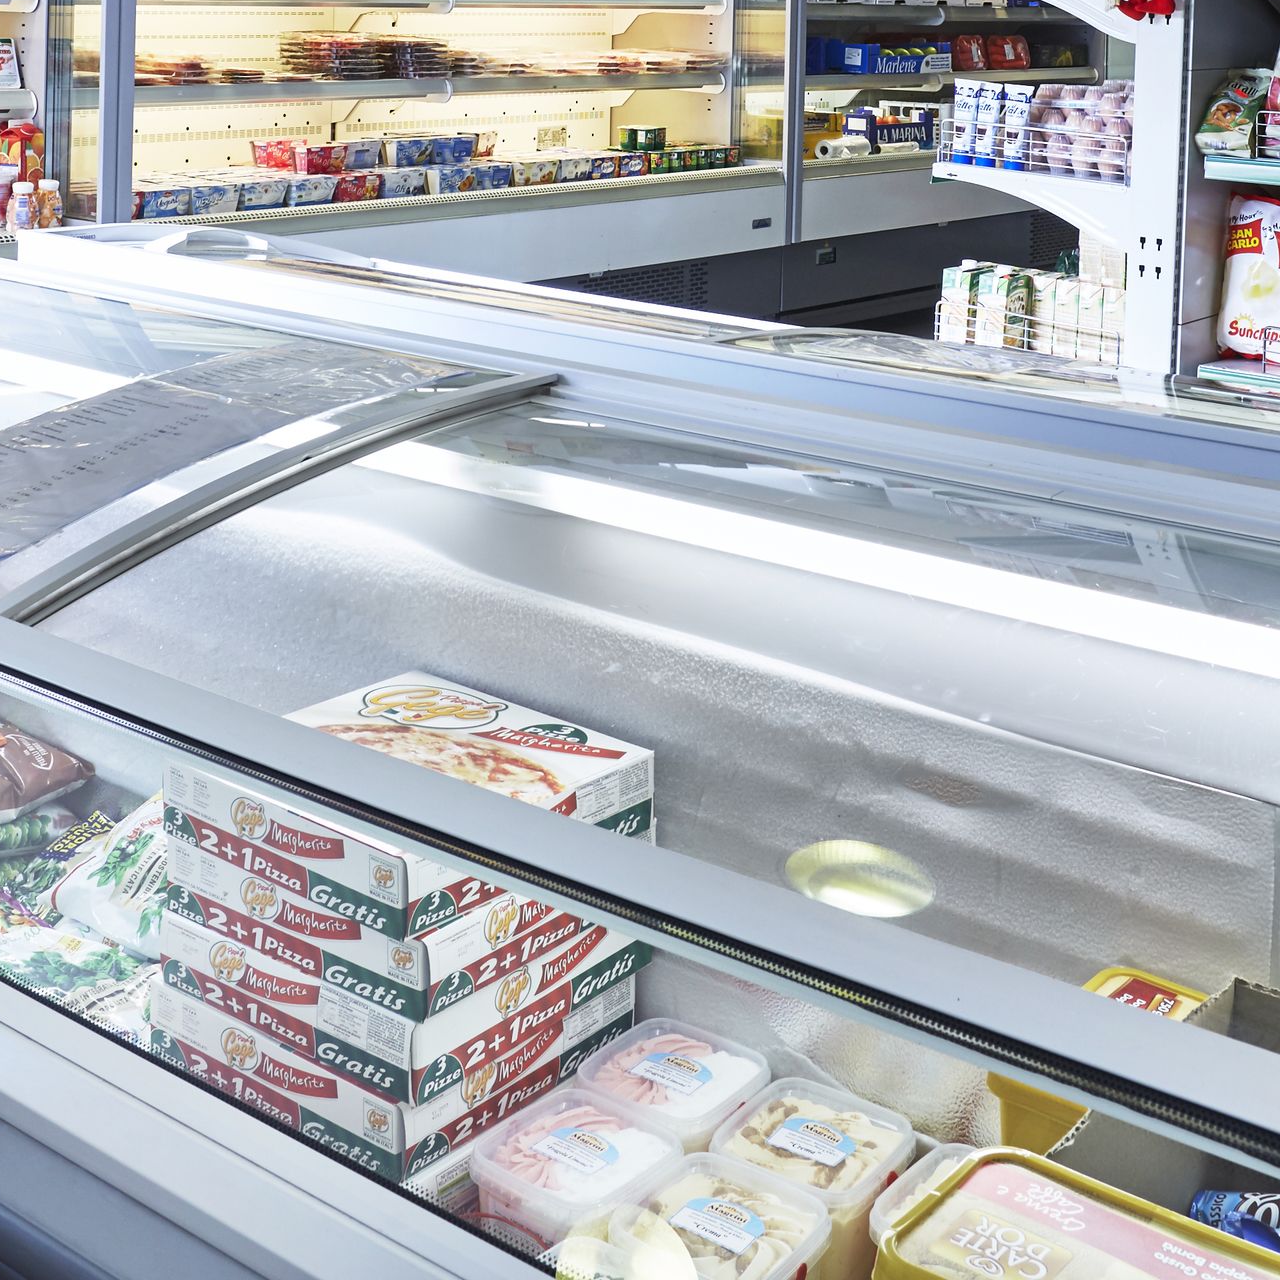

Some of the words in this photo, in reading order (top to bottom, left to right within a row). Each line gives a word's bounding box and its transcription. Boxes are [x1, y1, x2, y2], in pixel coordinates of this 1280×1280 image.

[874, 55, 917, 74] Marlene
[877, 129, 887, 142] LA
[891, 125, 927, 142] MARINA
[489, 726, 602, 754] Margherita
[560, 726, 575, 735] 3
[164, 822, 198, 847] Pizze
[271, 823, 332, 853] Margherita
[253, 858, 302, 892] Pizza
[309, 884, 388, 931] Gratis
[431, 890, 441, 910] 3
[169, 902, 204, 925] Pizze
[282, 903, 348, 936] Margherita
[415, 905, 455, 931] Pizze
[532, 921, 576, 954] Pizza
[542, 933, 597, 984] Margherita
[245, 968, 308, 999] Margherita
[264, 937, 316, 971] Pizza
[324, 965, 406, 1012] Gratis
[449, 972, 460, 991] 3
[435, 985, 473, 1012] Pizze
[520, 996, 566, 1033] Pizza
[573, 954, 636, 1005] Gratis
[259, 1012, 309, 1047] Pizza
[317, 1041, 395, 1089] Gratis
[437, 1055, 448, 1076] 3
[262, 1055, 325, 1090] Margherita
[424, 1068, 462, 1098] Pizze
[425, 1132, 436, 1153] 3
[410, 1144, 448, 1174] Pizze
[949, 1226, 1049, 1279] CARTE
